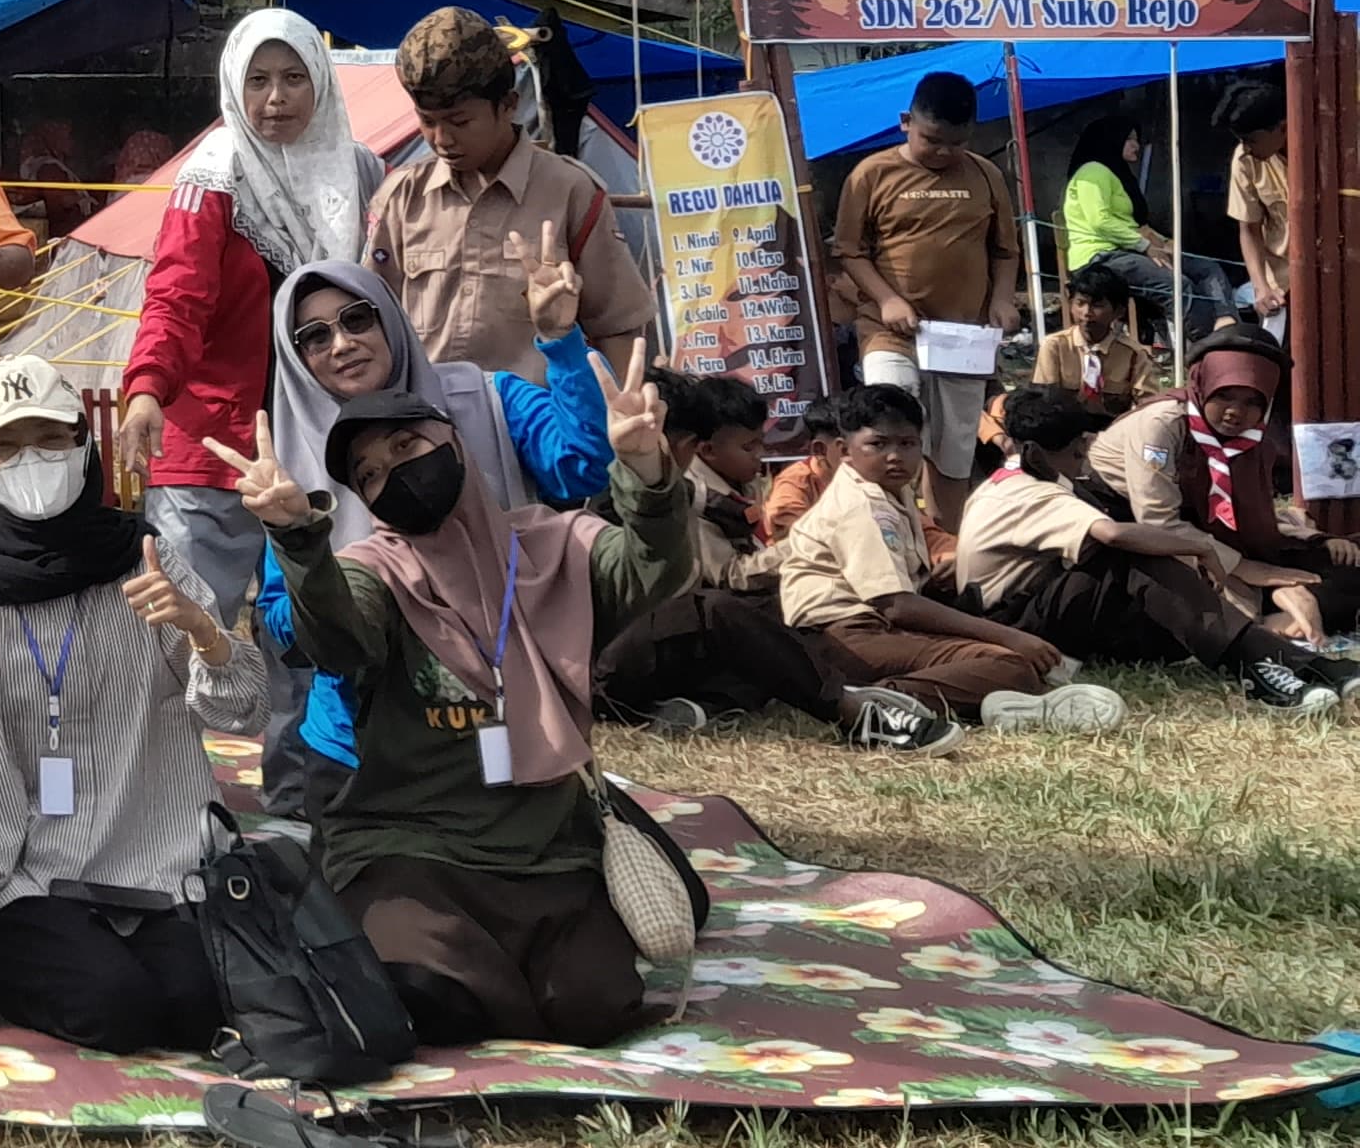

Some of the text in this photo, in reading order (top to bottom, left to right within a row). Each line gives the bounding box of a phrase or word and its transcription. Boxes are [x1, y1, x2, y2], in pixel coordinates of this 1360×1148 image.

[668, 179, 783, 215] REGU DAHLIA
[747, 223, 776, 244] April
[1, 372, 34, 403] NY
